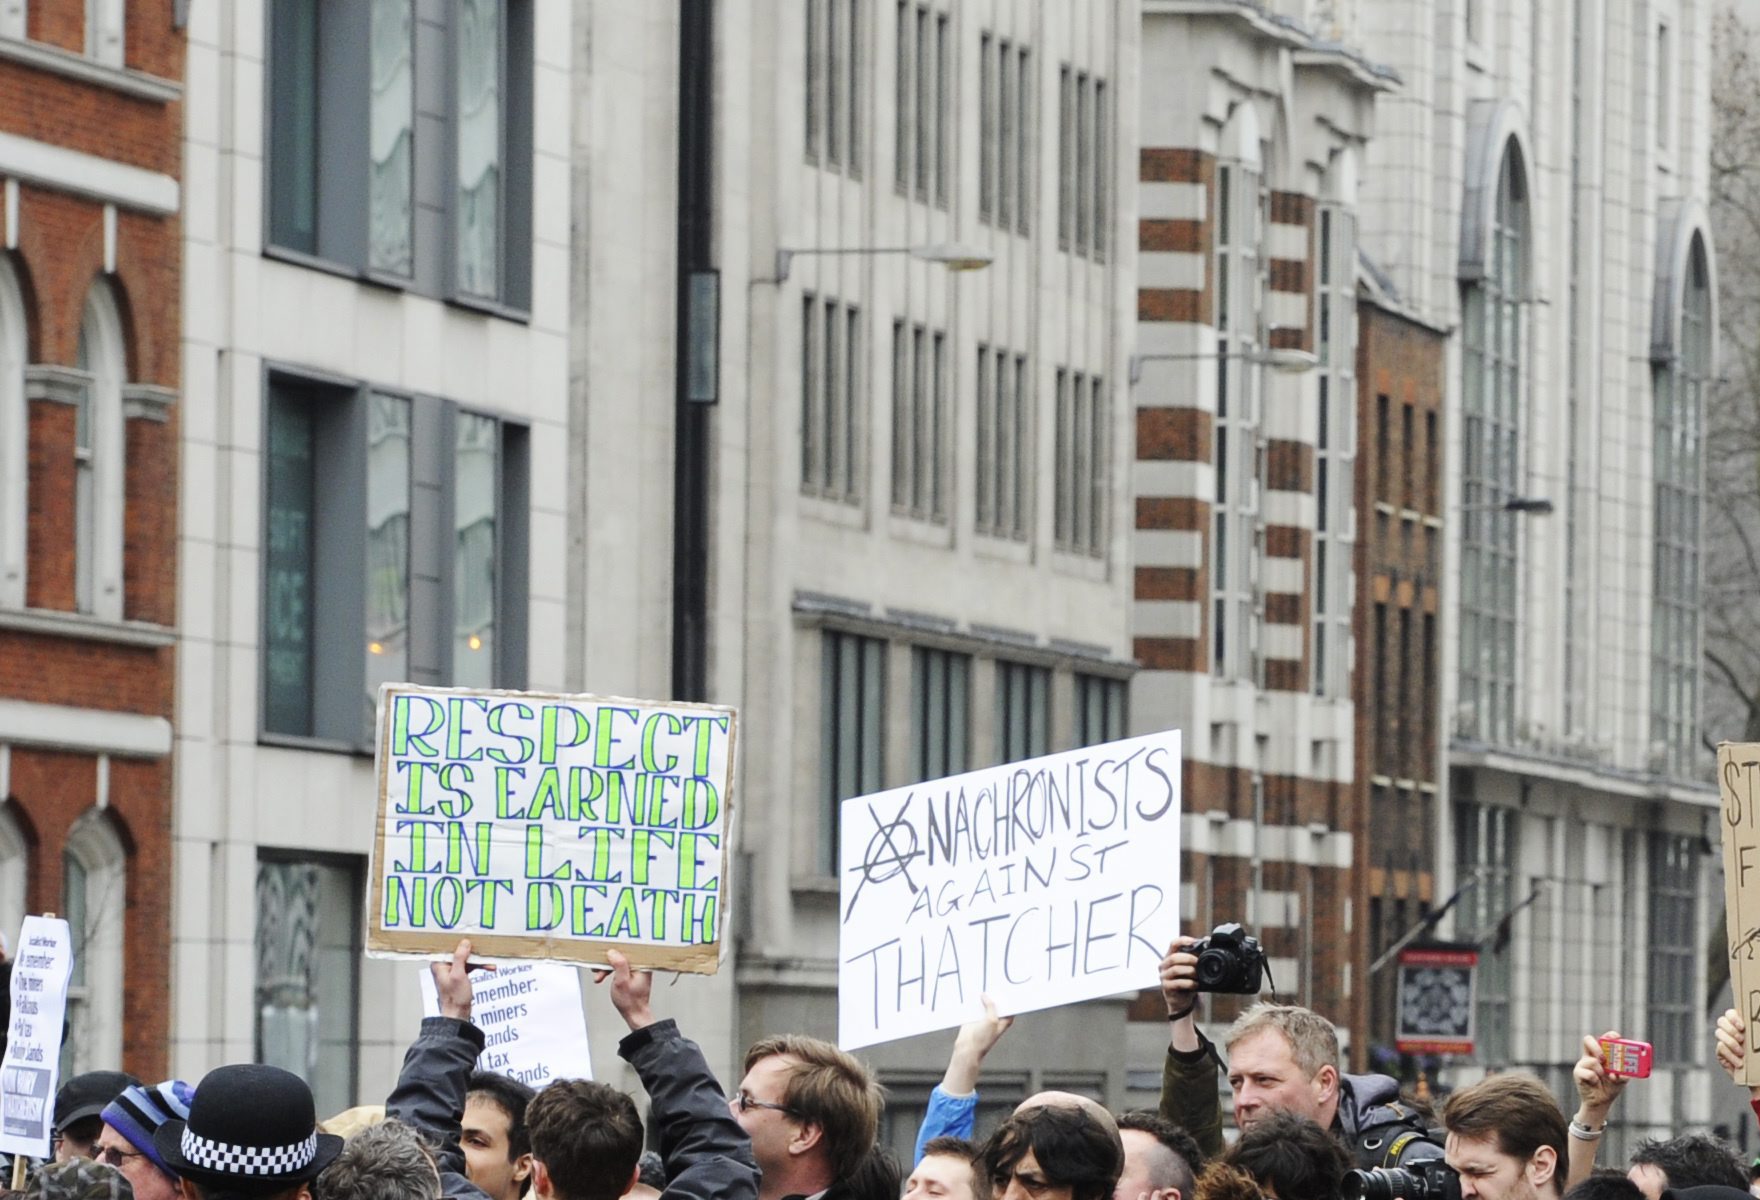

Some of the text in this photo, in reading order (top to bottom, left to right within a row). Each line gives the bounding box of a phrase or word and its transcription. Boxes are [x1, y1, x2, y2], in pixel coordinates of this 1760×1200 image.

[392, 695, 729, 777] RESPECT
[395, 760, 719, 831] IS EARNED
[395, 820, 719, 891] IN LIFE
[905, 838, 1131, 924] AGAINST
[385, 875, 718, 945] NOT DEATH
[845, 883, 1165, 1030] THATCHER
[481, 1004, 528, 1026] miners
[487, 1051, 510, 1069] tax
